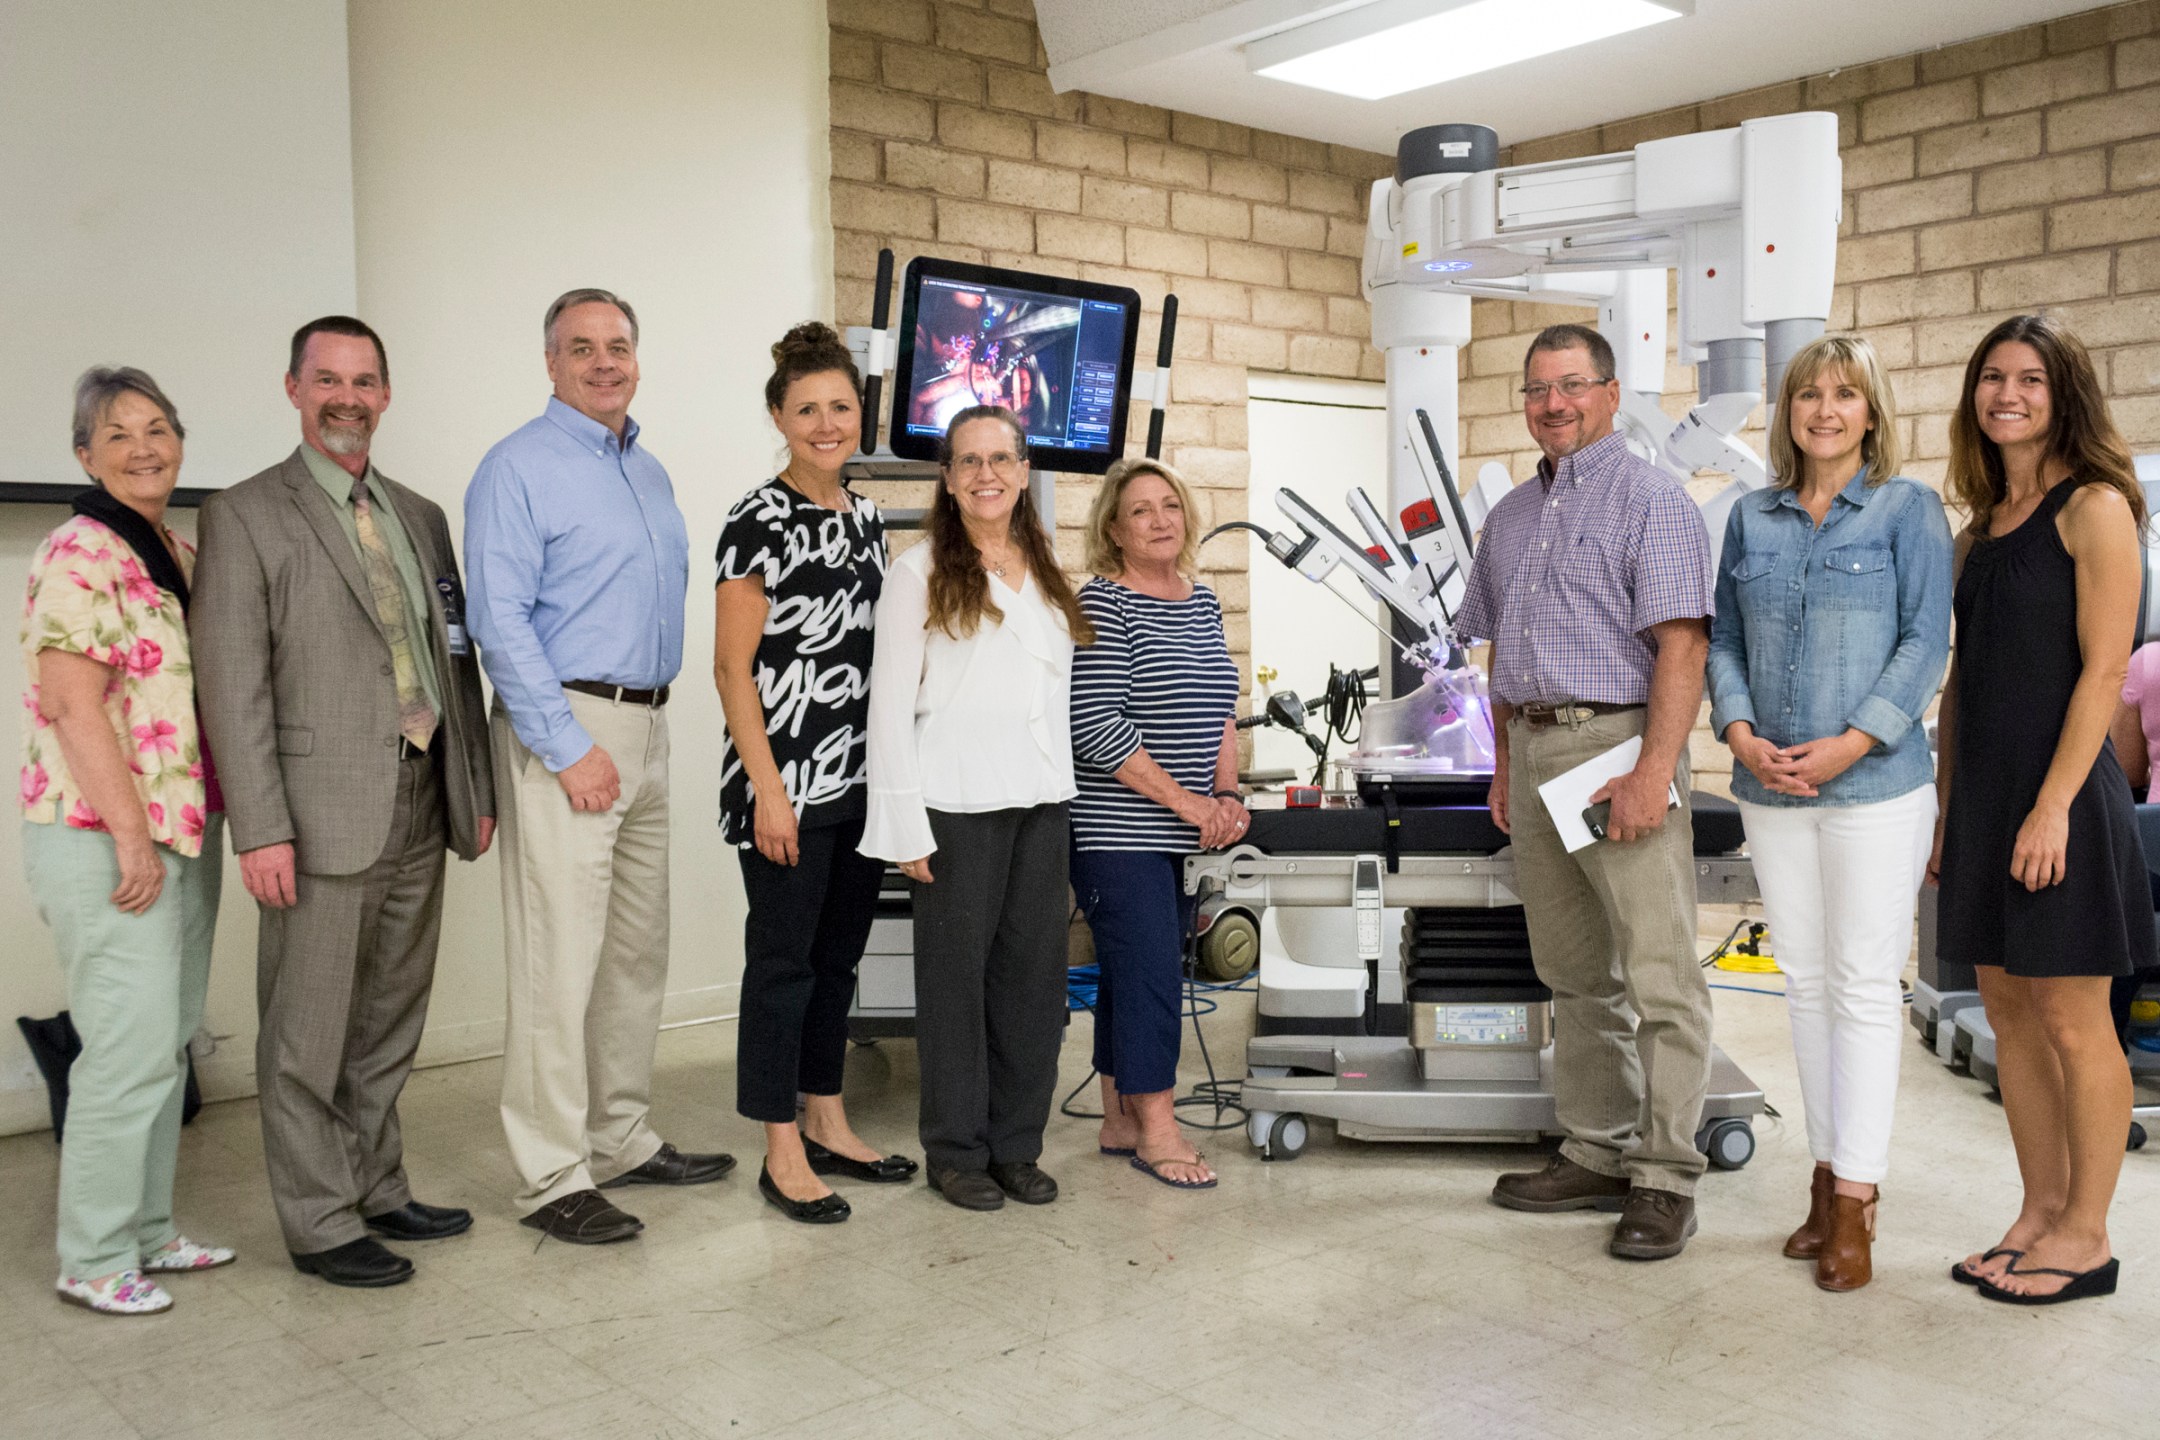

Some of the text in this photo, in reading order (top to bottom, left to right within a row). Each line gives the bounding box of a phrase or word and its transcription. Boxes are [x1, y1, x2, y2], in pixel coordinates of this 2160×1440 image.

[1608, 308, 1613, 322] 1
[1433, 541, 1442, 552] 3
[1320, 554, 1330, 564] 2
